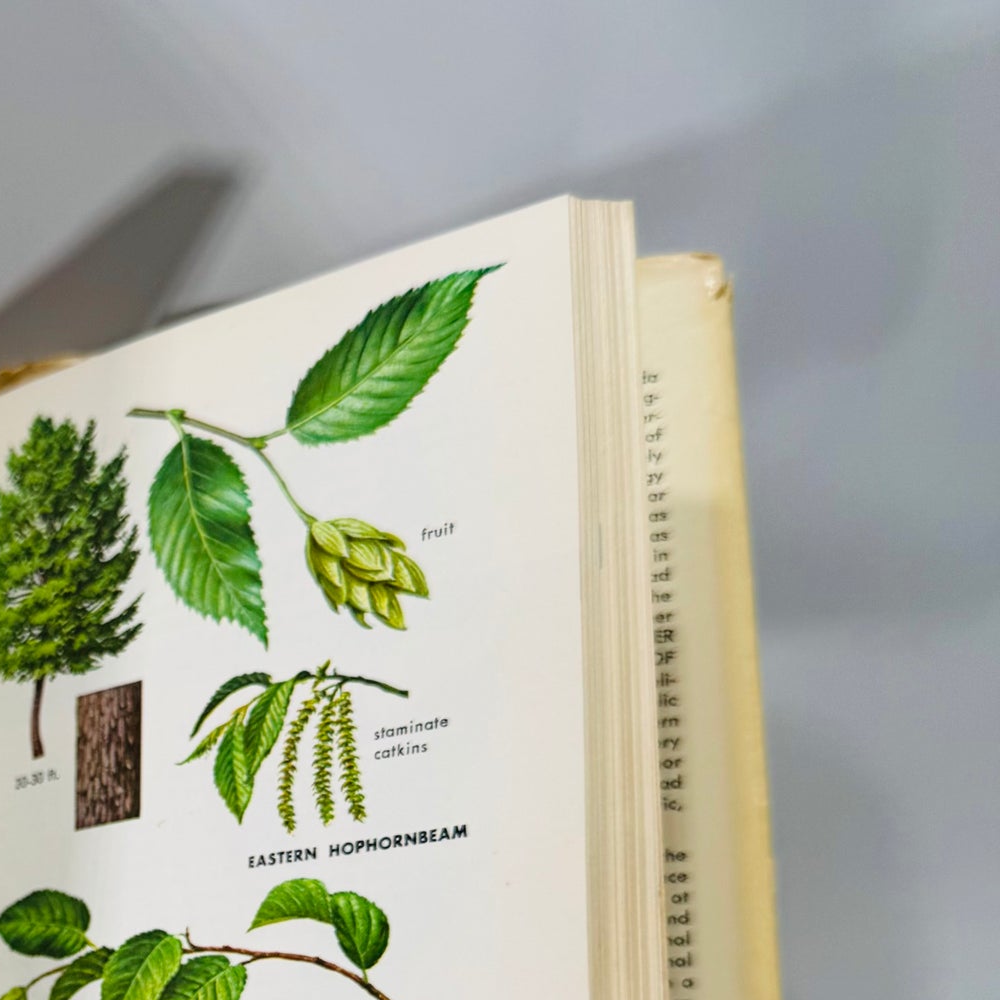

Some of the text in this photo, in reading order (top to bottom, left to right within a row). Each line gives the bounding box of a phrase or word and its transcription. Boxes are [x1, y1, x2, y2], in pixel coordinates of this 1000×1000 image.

[421, 522, 455, 542] fruit
[373, 716, 449, 741] staminate
[373, 741, 428, 760] catkins
[248, 823, 468, 869] EASTERN HOPHORNBEAM
